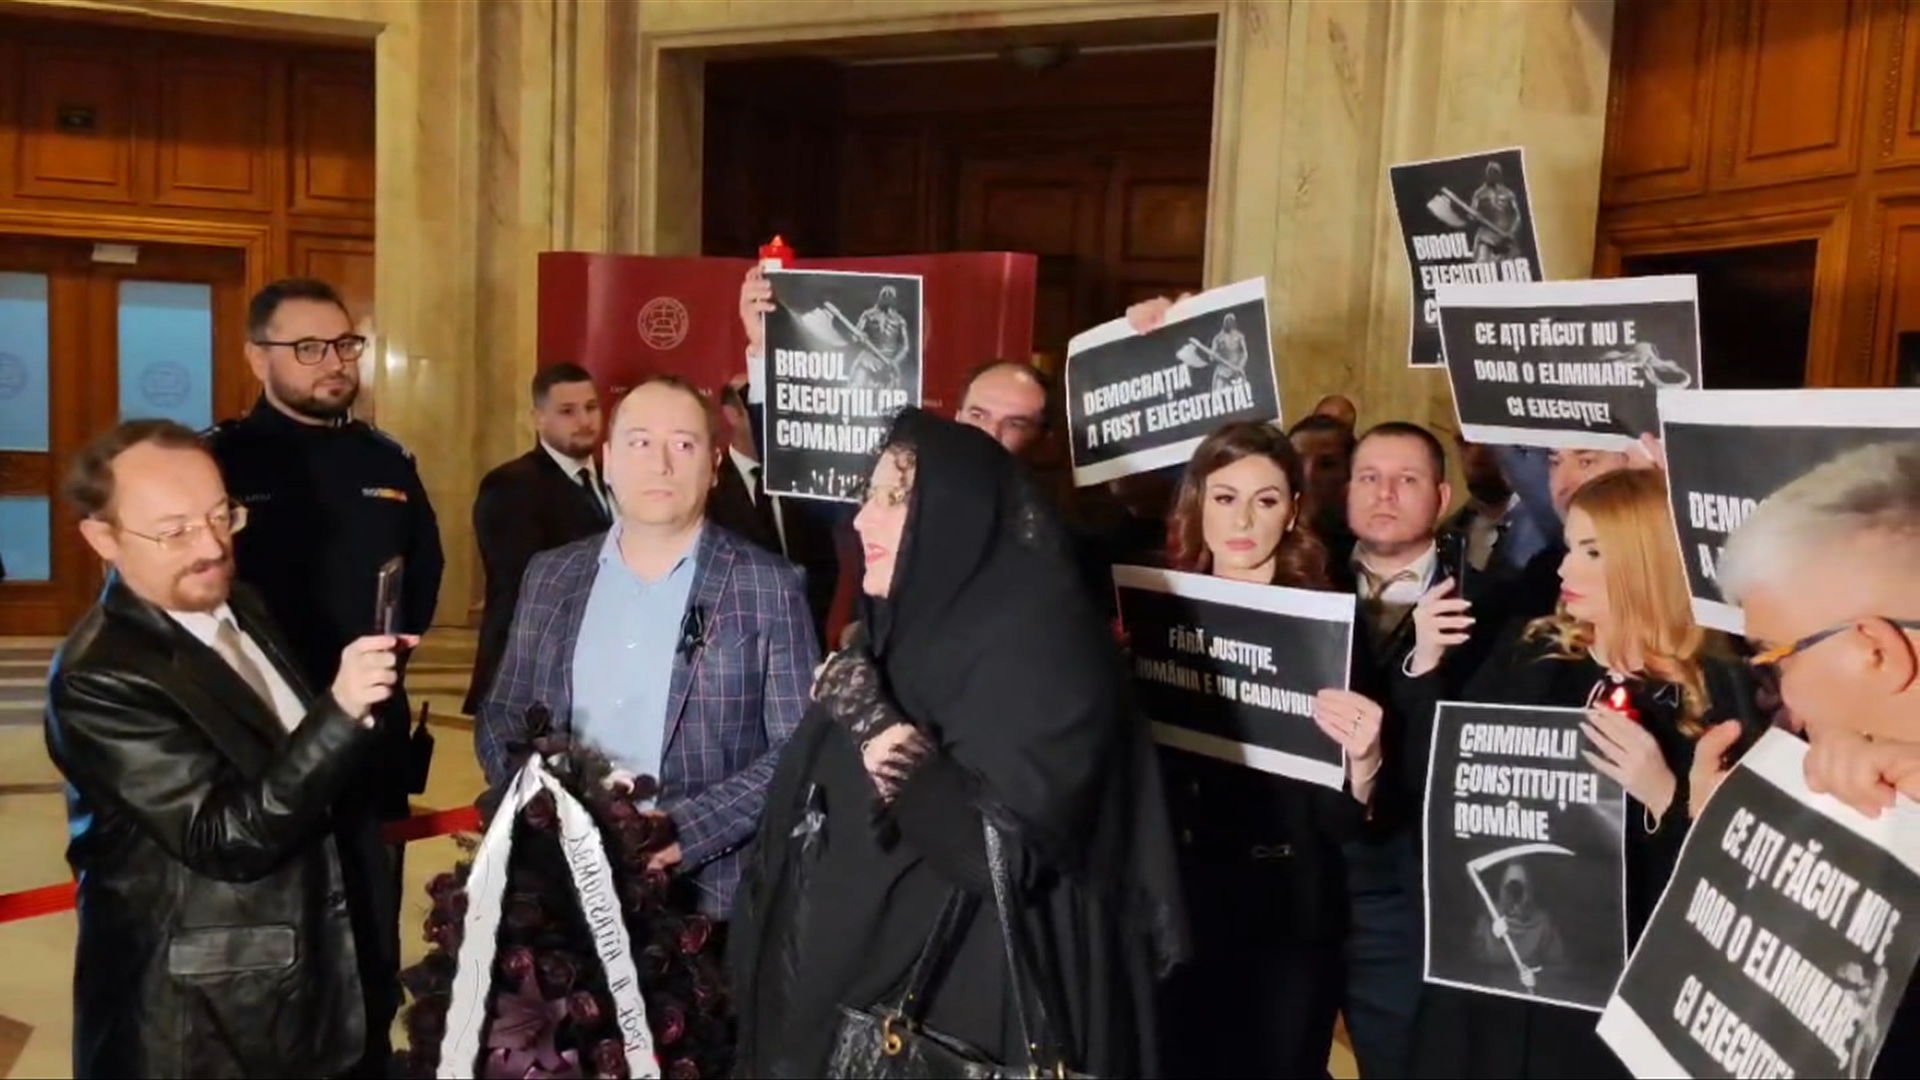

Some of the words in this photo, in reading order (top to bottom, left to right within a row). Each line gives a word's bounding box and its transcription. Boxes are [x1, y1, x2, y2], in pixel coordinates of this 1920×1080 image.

[1475, 322, 1497, 345] CE
[1500, 322, 1526, 354] AȚI
[1530, 317, 1586, 348] FĂCUT
[1591, 323, 1617, 347] NU
[1624, 321, 1636, 344] E
[775, 348, 849, 381] BIROUL
[1474, 359, 1519, 383] DOAR
[1524, 363, 1535, 383] O
[1539, 362, 1645, 389] ELIMINARE,
[1083, 363, 1192, 417] DEMOCRAȚIA
[1087, 424, 1098, 449] A
[1102, 410, 1141, 444] FOST
[1145, 378, 1255, 433] EXECUTATĂ!
[1507, 398, 1526, 417] CI
[1528, 398, 1610, 428] EXECUȚIE!
[776, 419, 886, 454] COMANDA
[1168, 624, 1206, 655] FĂRĂ
[1209, 636, 1278, 675] JUSTIȚIE,
[1204, 674, 1213, 694] E
[1216, 675, 1237, 701] UN
[1459, 723, 1578, 760] CRIMINALII
[1454, 763, 1598, 812] CONSTITUȚIEI
[1454, 801, 1549, 841] ROMÂNE
[1720, 806, 1757, 859] CE
[1741, 820, 1786, 890] AȚI
[1771, 838, 1861, 931] FĂCUT
[1845, 883, 1892, 956] NU
[1873, 909, 1902, 967] E
[1685, 877, 1738, 951] DOAR
[1726, 913, 1754, 964] O
[1741, 925, 1861, 1071] ELIMINARE,
[1672, 973, 1703, 1030] CI
